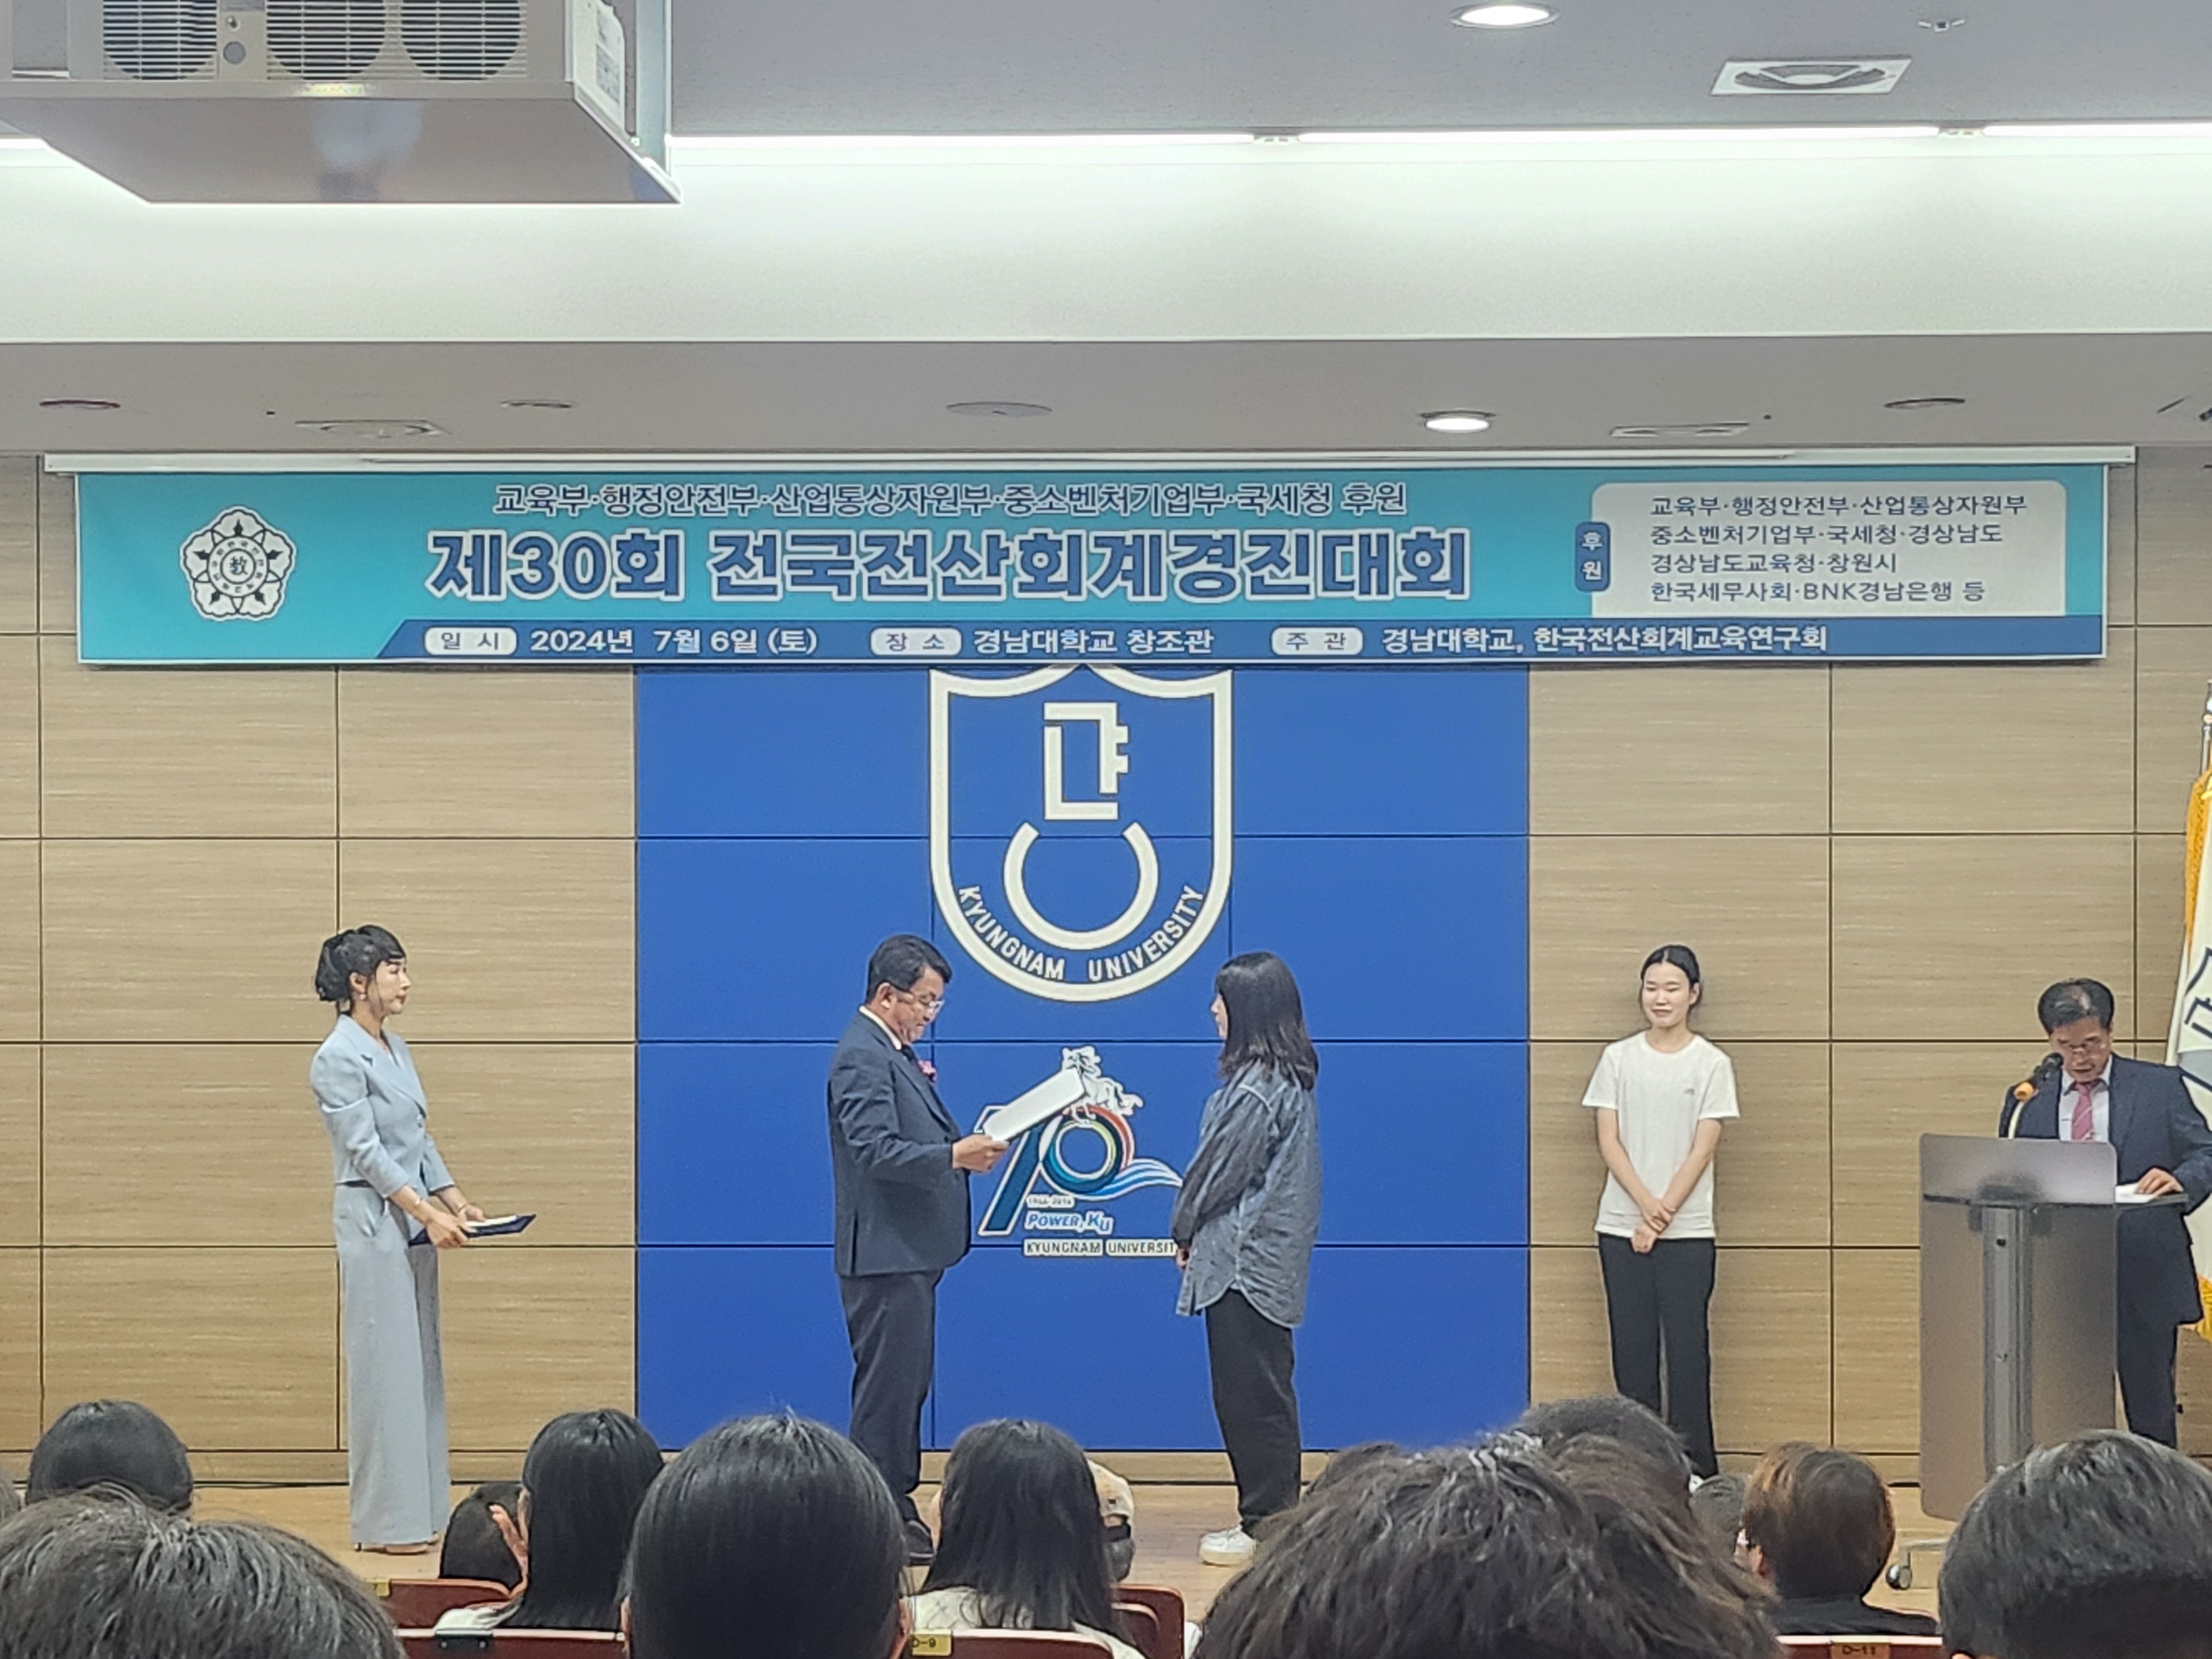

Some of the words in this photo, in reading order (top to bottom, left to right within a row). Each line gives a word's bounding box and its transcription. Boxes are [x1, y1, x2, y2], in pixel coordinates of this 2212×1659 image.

[1342, 483, 1407, 515] 후원
[426, 528, 685, 602] 제30회
[708, 527, 1470, 603] 전국전산회계경진대회
[1963, 582, 1985, 601] 등
[530, 629, 634, 654] 2024년
[653, 629, 701, 654] 7월
[711, 629, 758, 654] 6일
[768, 628, 818, 654] (토)
[973, 629, 1118, 654] 경남대학교
[1126, 628, 1214, 654] 창조관
[1382, 627, 1524, 654] 경남대학교,
[1533, 625, 1827, 653] 한국전산회계교육연구회
[959, 885, 1065, 980] KYUNGNAM
[1088, 885, 1204, 982] UNIVERSITY
[1027, 1241, 1101, 1253] KYUNGNAM
[1108, 1241, 1176, 1253] UNIVERSIT
